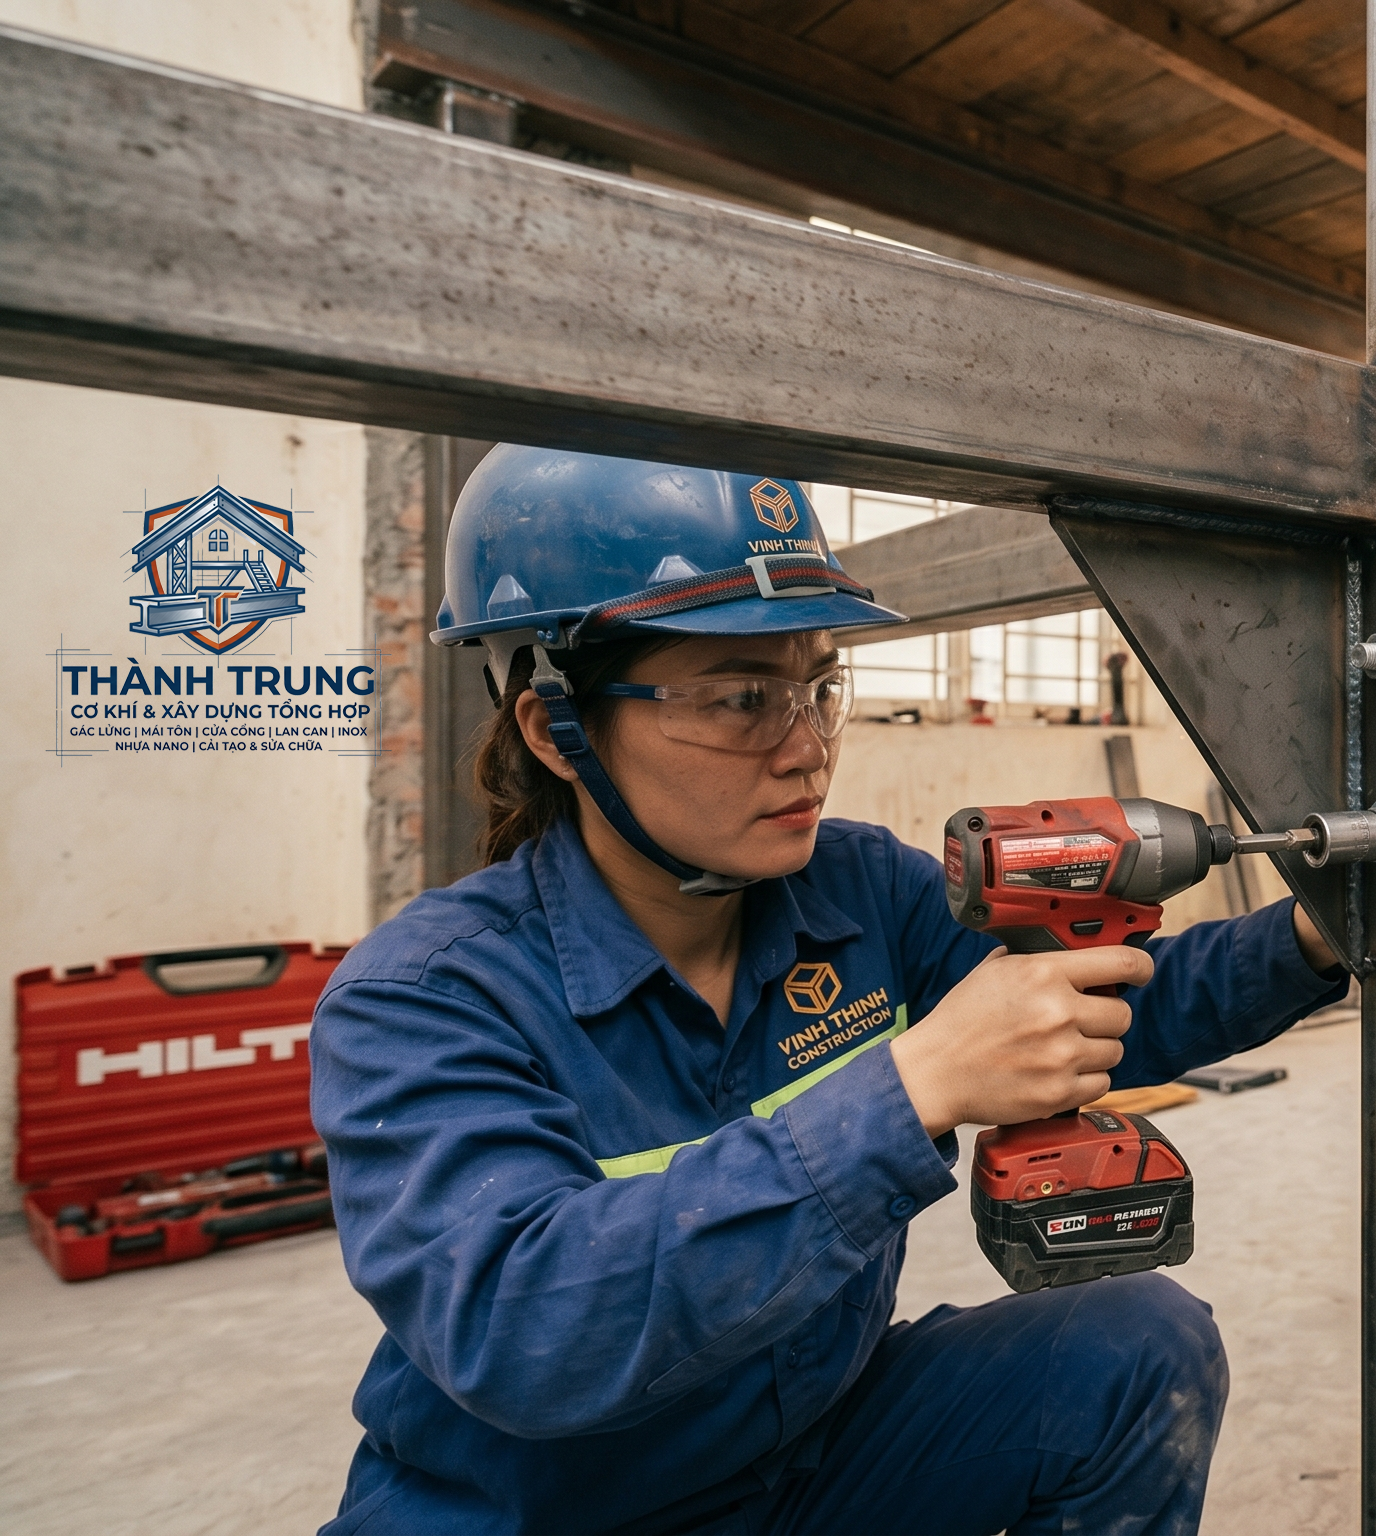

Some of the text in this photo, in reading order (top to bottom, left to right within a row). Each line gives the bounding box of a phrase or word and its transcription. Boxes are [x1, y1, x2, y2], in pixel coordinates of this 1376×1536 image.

[748, 540, 784, 553] VINH
[777, 987, 889, 1056] VINH THINH
[787, 1006, 892, 1070] CONSTRUCTION
[76, 1022, 313, 1087] HILT
